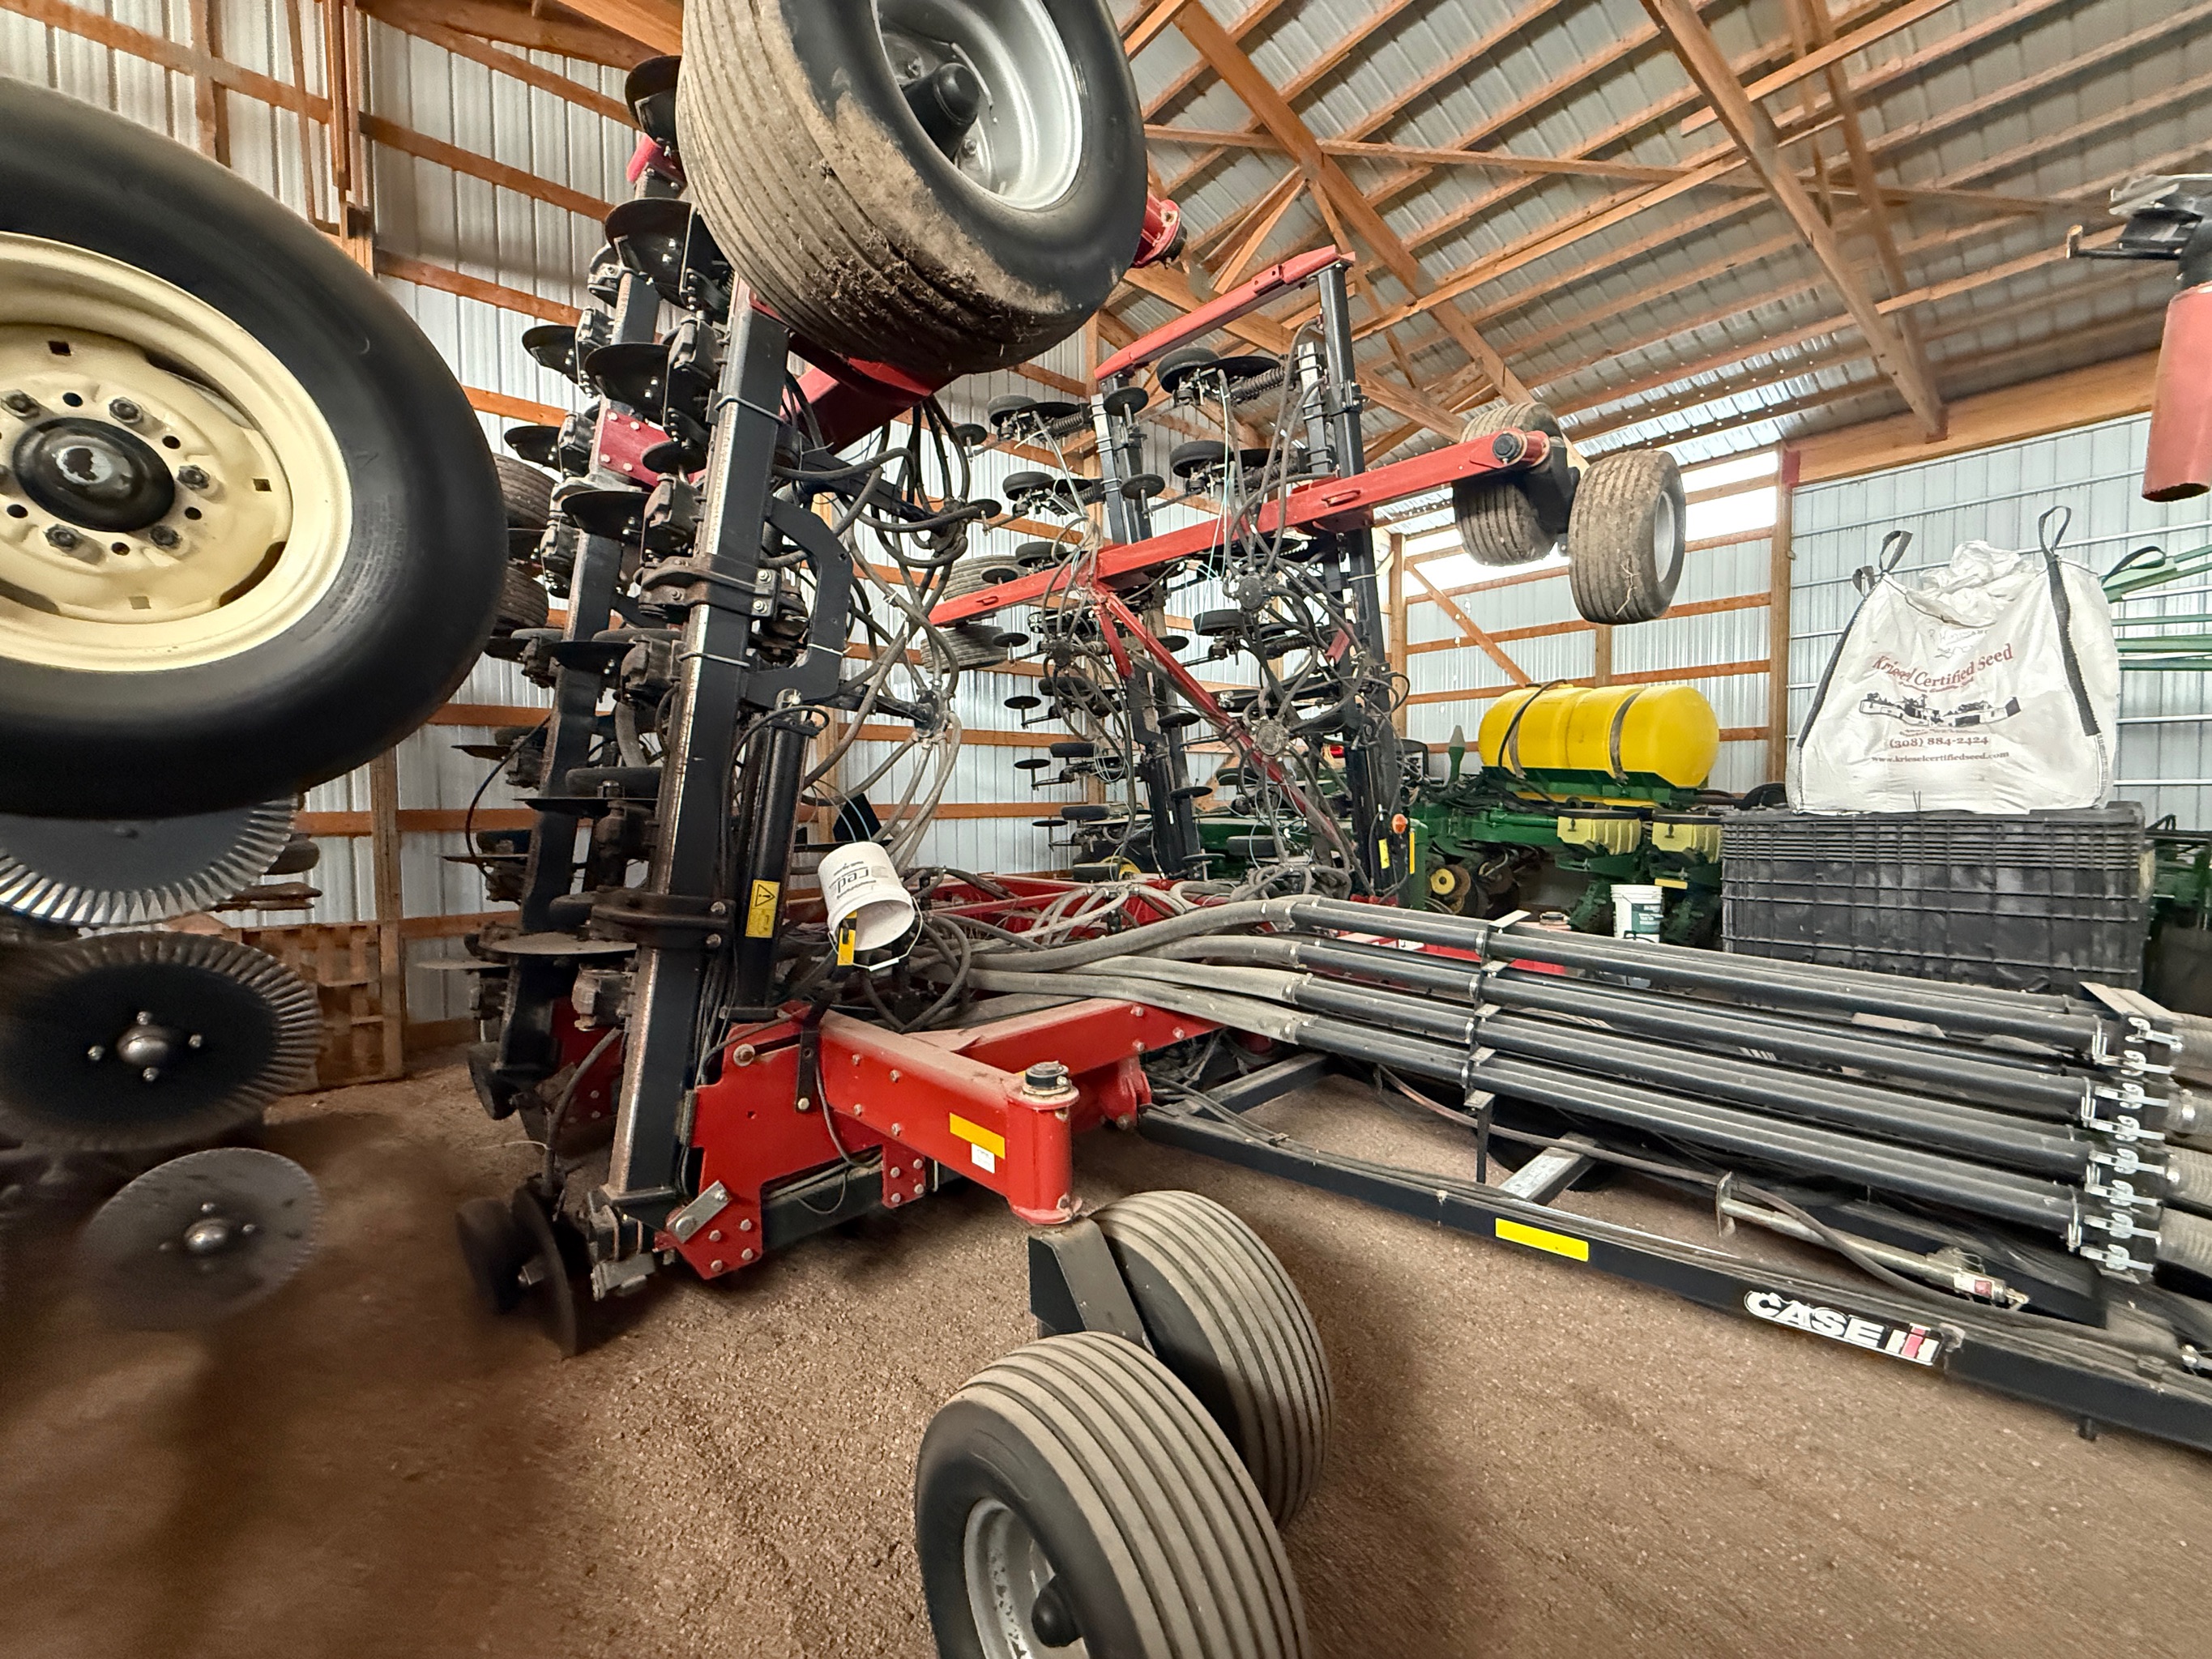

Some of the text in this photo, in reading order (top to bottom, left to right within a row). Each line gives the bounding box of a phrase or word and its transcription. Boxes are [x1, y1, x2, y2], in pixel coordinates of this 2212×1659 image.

[1914, 661, 1975, 687] Certified
[1977, 642, 2013, 672] Seed
[1889, 738, 1924, 748] (308)
[1745, 1291, 1885, 1348] CASE
